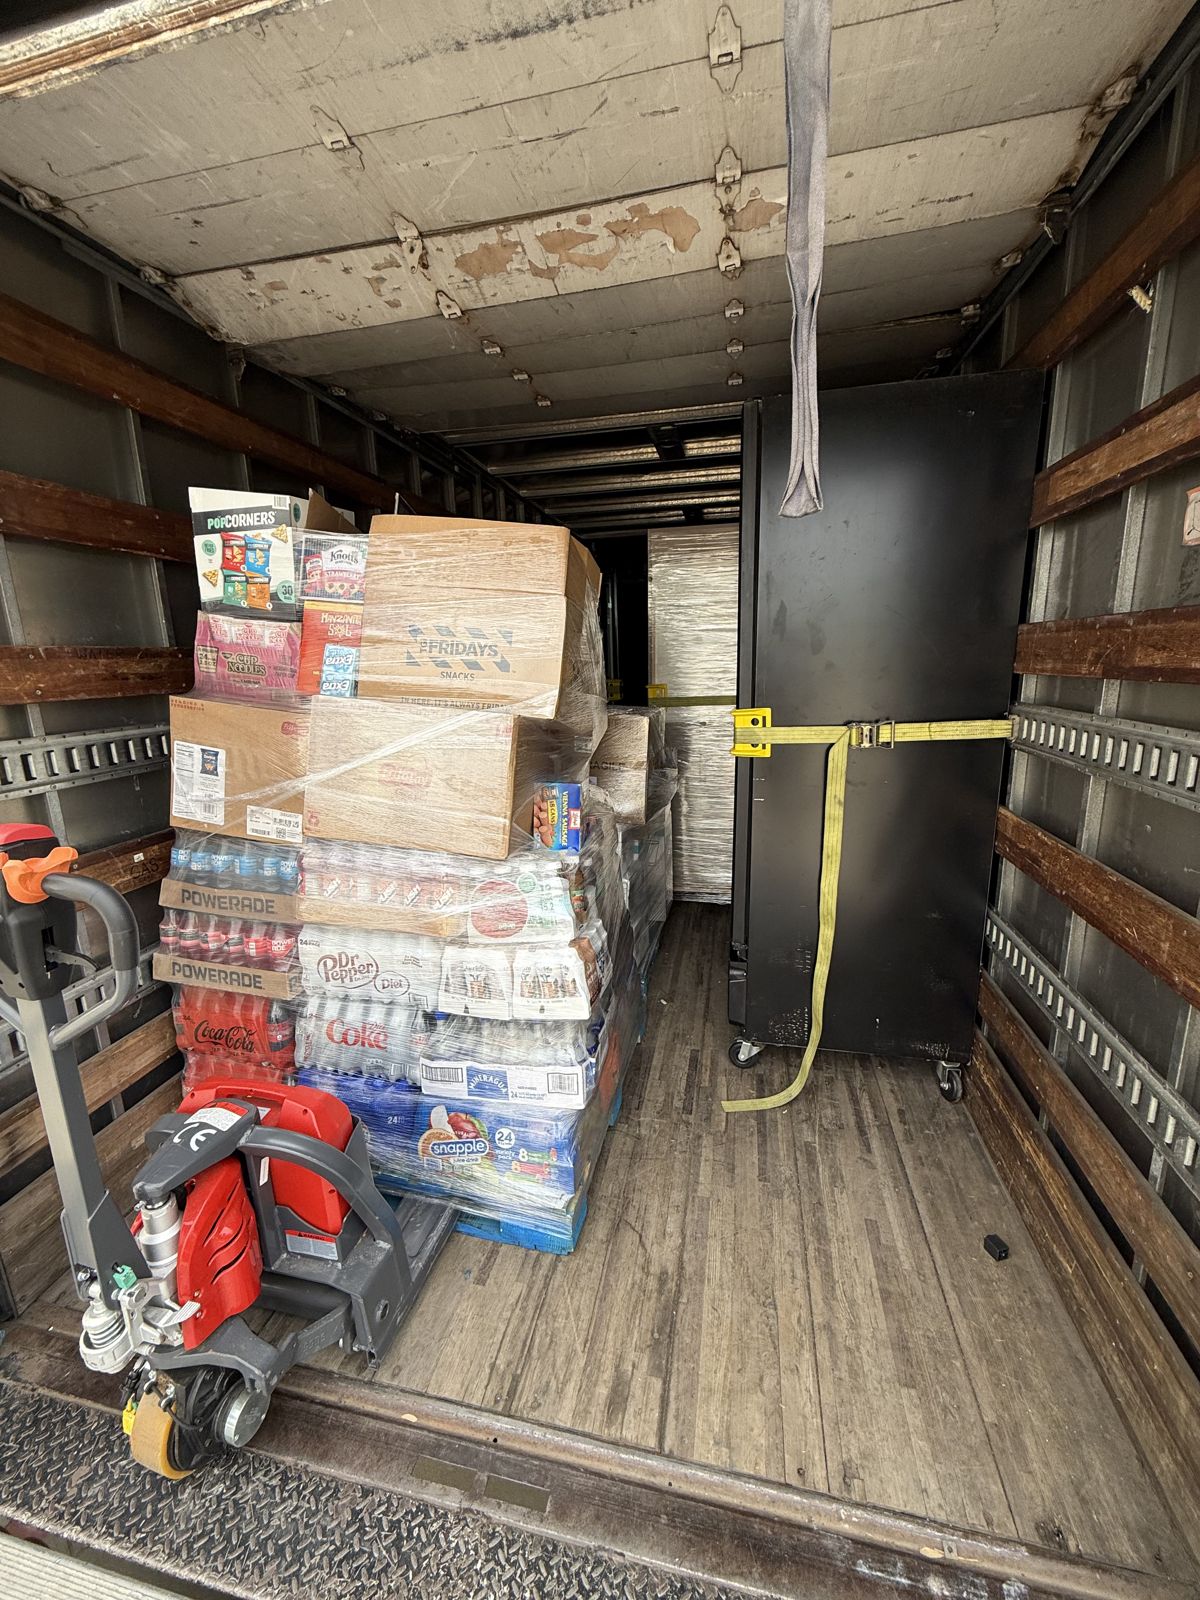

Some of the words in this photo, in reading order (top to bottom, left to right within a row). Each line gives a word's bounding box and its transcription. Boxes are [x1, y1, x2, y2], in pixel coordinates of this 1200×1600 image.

[207, 511, 276, 530] POPCORNERS
[281, 585, 293, 595] 30
[428, 639, 498, 657] FRIDAYS
[236, 654, 258, 665] CUP
[227, 662, 266, 676] NOODLES
[440, 671, 475, 681] SNACKS
[181, 889, 276, 914] POWERADE
[338, 951, 359, 968] Dr
[172, 962, 263, 990] POWERADE
[320, 954, 374, 983] Pepper
[381, 979, 403, 990] Diet
[194, 1020, 257, 1053] Coca-Cola
[326, 1018, 389, 1050] Coke
[468, 1074, 508, 1093] MINERAGUA
[388, 1116, 397, 1124] 24
[497, 1131, 512, 1142] 24
[433, 1140, 485, 1156] snapple
[519, 1148, 528, 1161] 8
